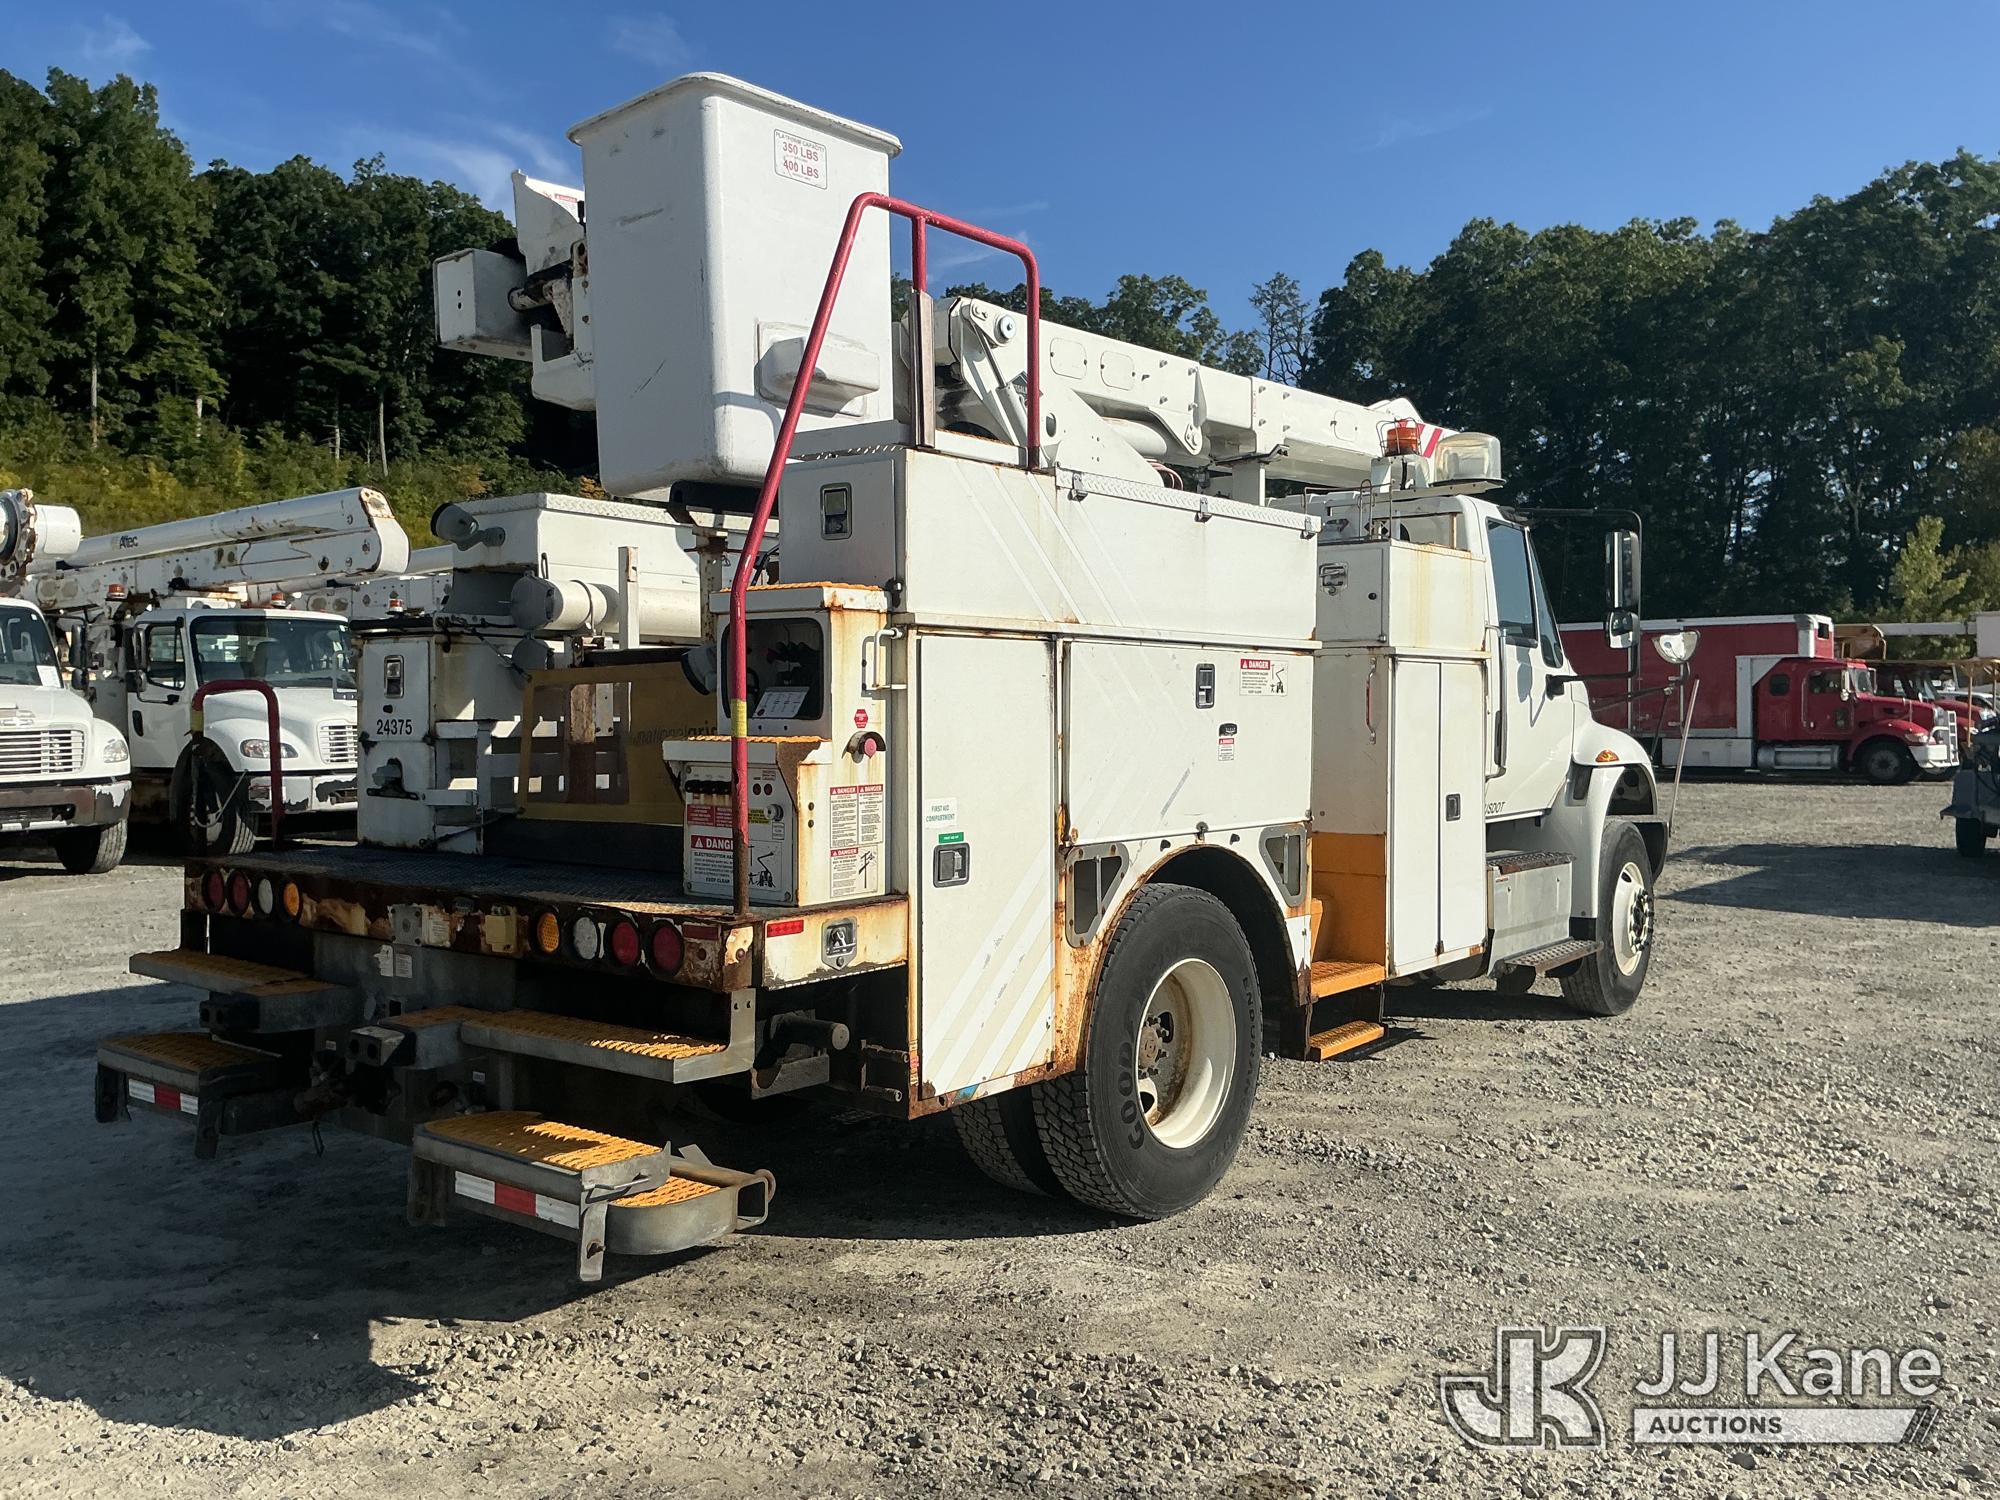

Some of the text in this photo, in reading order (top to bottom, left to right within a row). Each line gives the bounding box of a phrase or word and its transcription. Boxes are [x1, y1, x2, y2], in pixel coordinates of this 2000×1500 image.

[783, 141, 798, 156] 350
[800, 147, 819, 162] LBS
[783, 160, 799, 173] 400
[801, 164, 819, 179] LBS
[120, 535, 139, 549] Altec
[1248, 661, 1269, 669] DANGER
[376, 718, 413, 735] 24375
[705, 837, 734, 850] DANG
